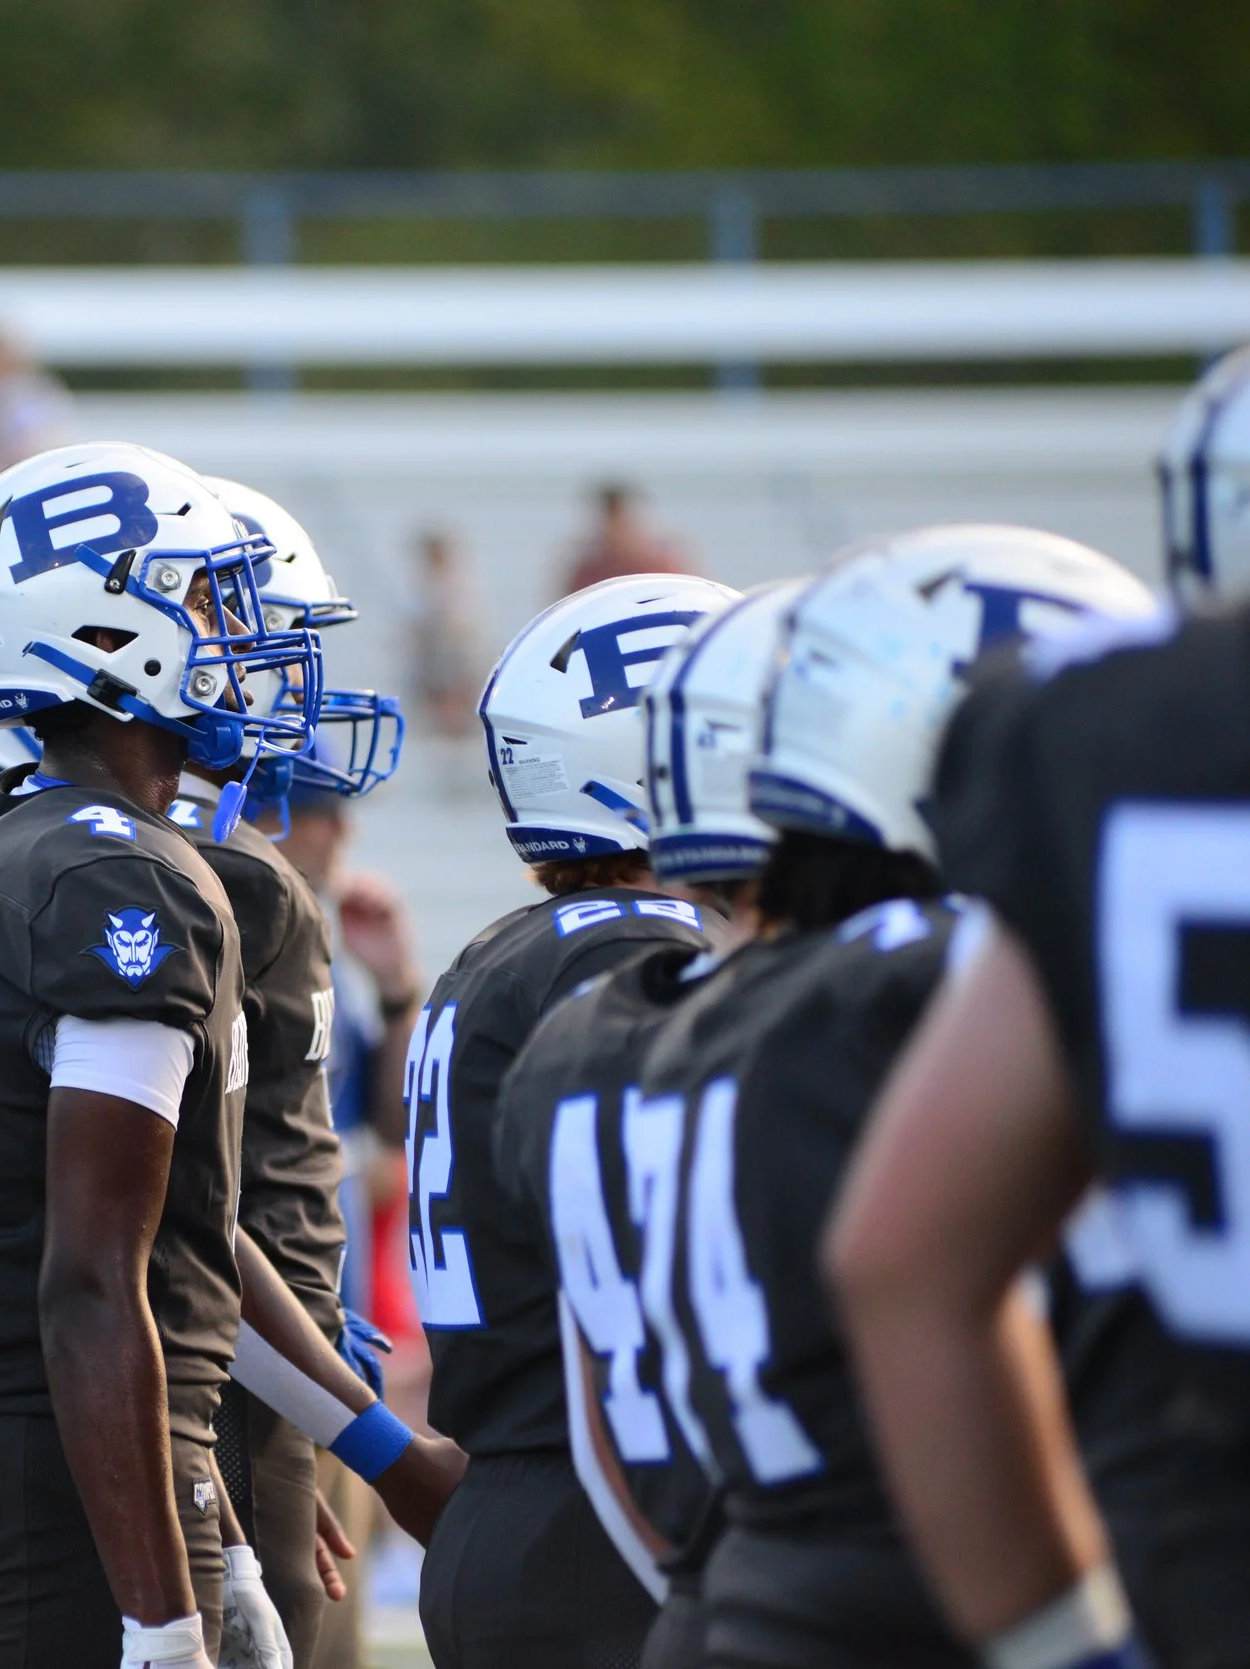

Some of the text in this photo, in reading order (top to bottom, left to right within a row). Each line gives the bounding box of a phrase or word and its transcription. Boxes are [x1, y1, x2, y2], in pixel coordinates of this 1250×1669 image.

[3, 471, 159, 585] B
[500, 747, 514, 765] 22
[67, 803, 137, 842] 4
[554, 898, 704, 940] 22
[403, 1000, 488, 1331] 22
